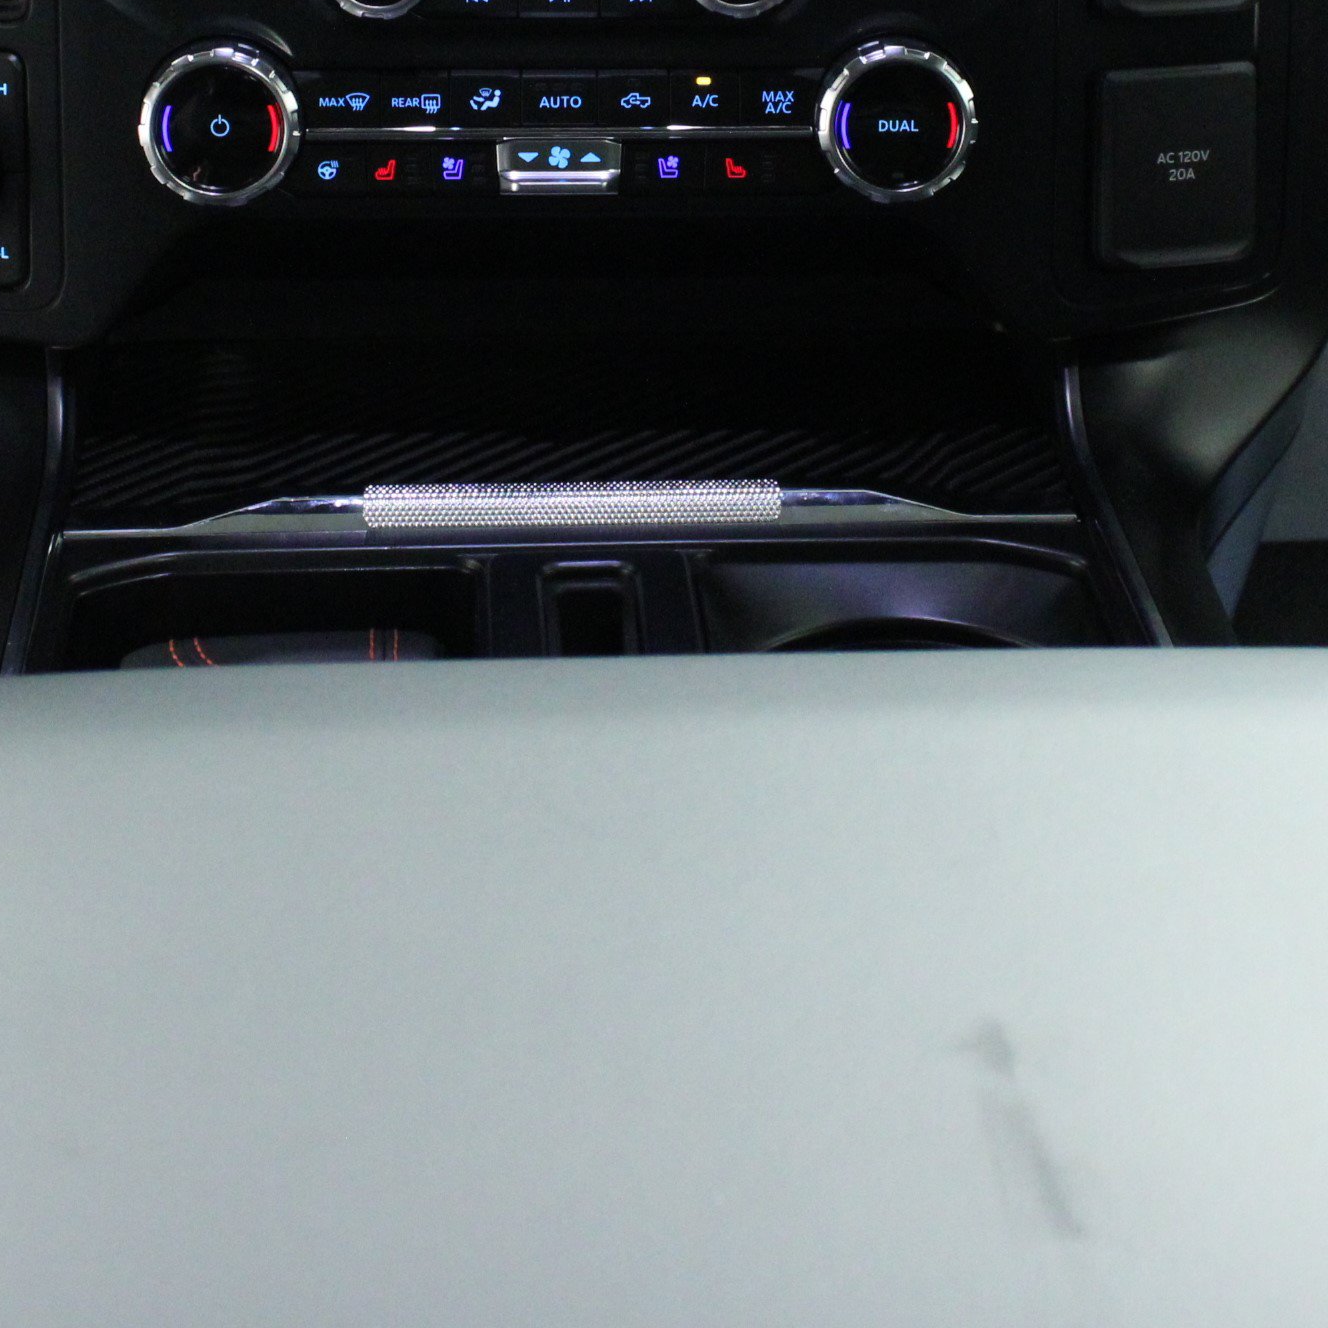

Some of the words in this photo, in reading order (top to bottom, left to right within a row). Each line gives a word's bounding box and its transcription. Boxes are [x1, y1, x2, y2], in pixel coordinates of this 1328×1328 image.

[319, 97, 346, 108] MAX
[391, 97, 420, 108] REAR
[539, 96, 582, 109] AUTO
[692, 95, 719, 108] A/C
[762, 90, 795, 103] MAX
[765, 101, 792, 114] A/C
[878, 120, 919, 133] DUAL
[1157, 152, 1176, 165] AC
[1178, 149, 1210, 163] 120V
[1168, 168, 1196, 181] 20A
